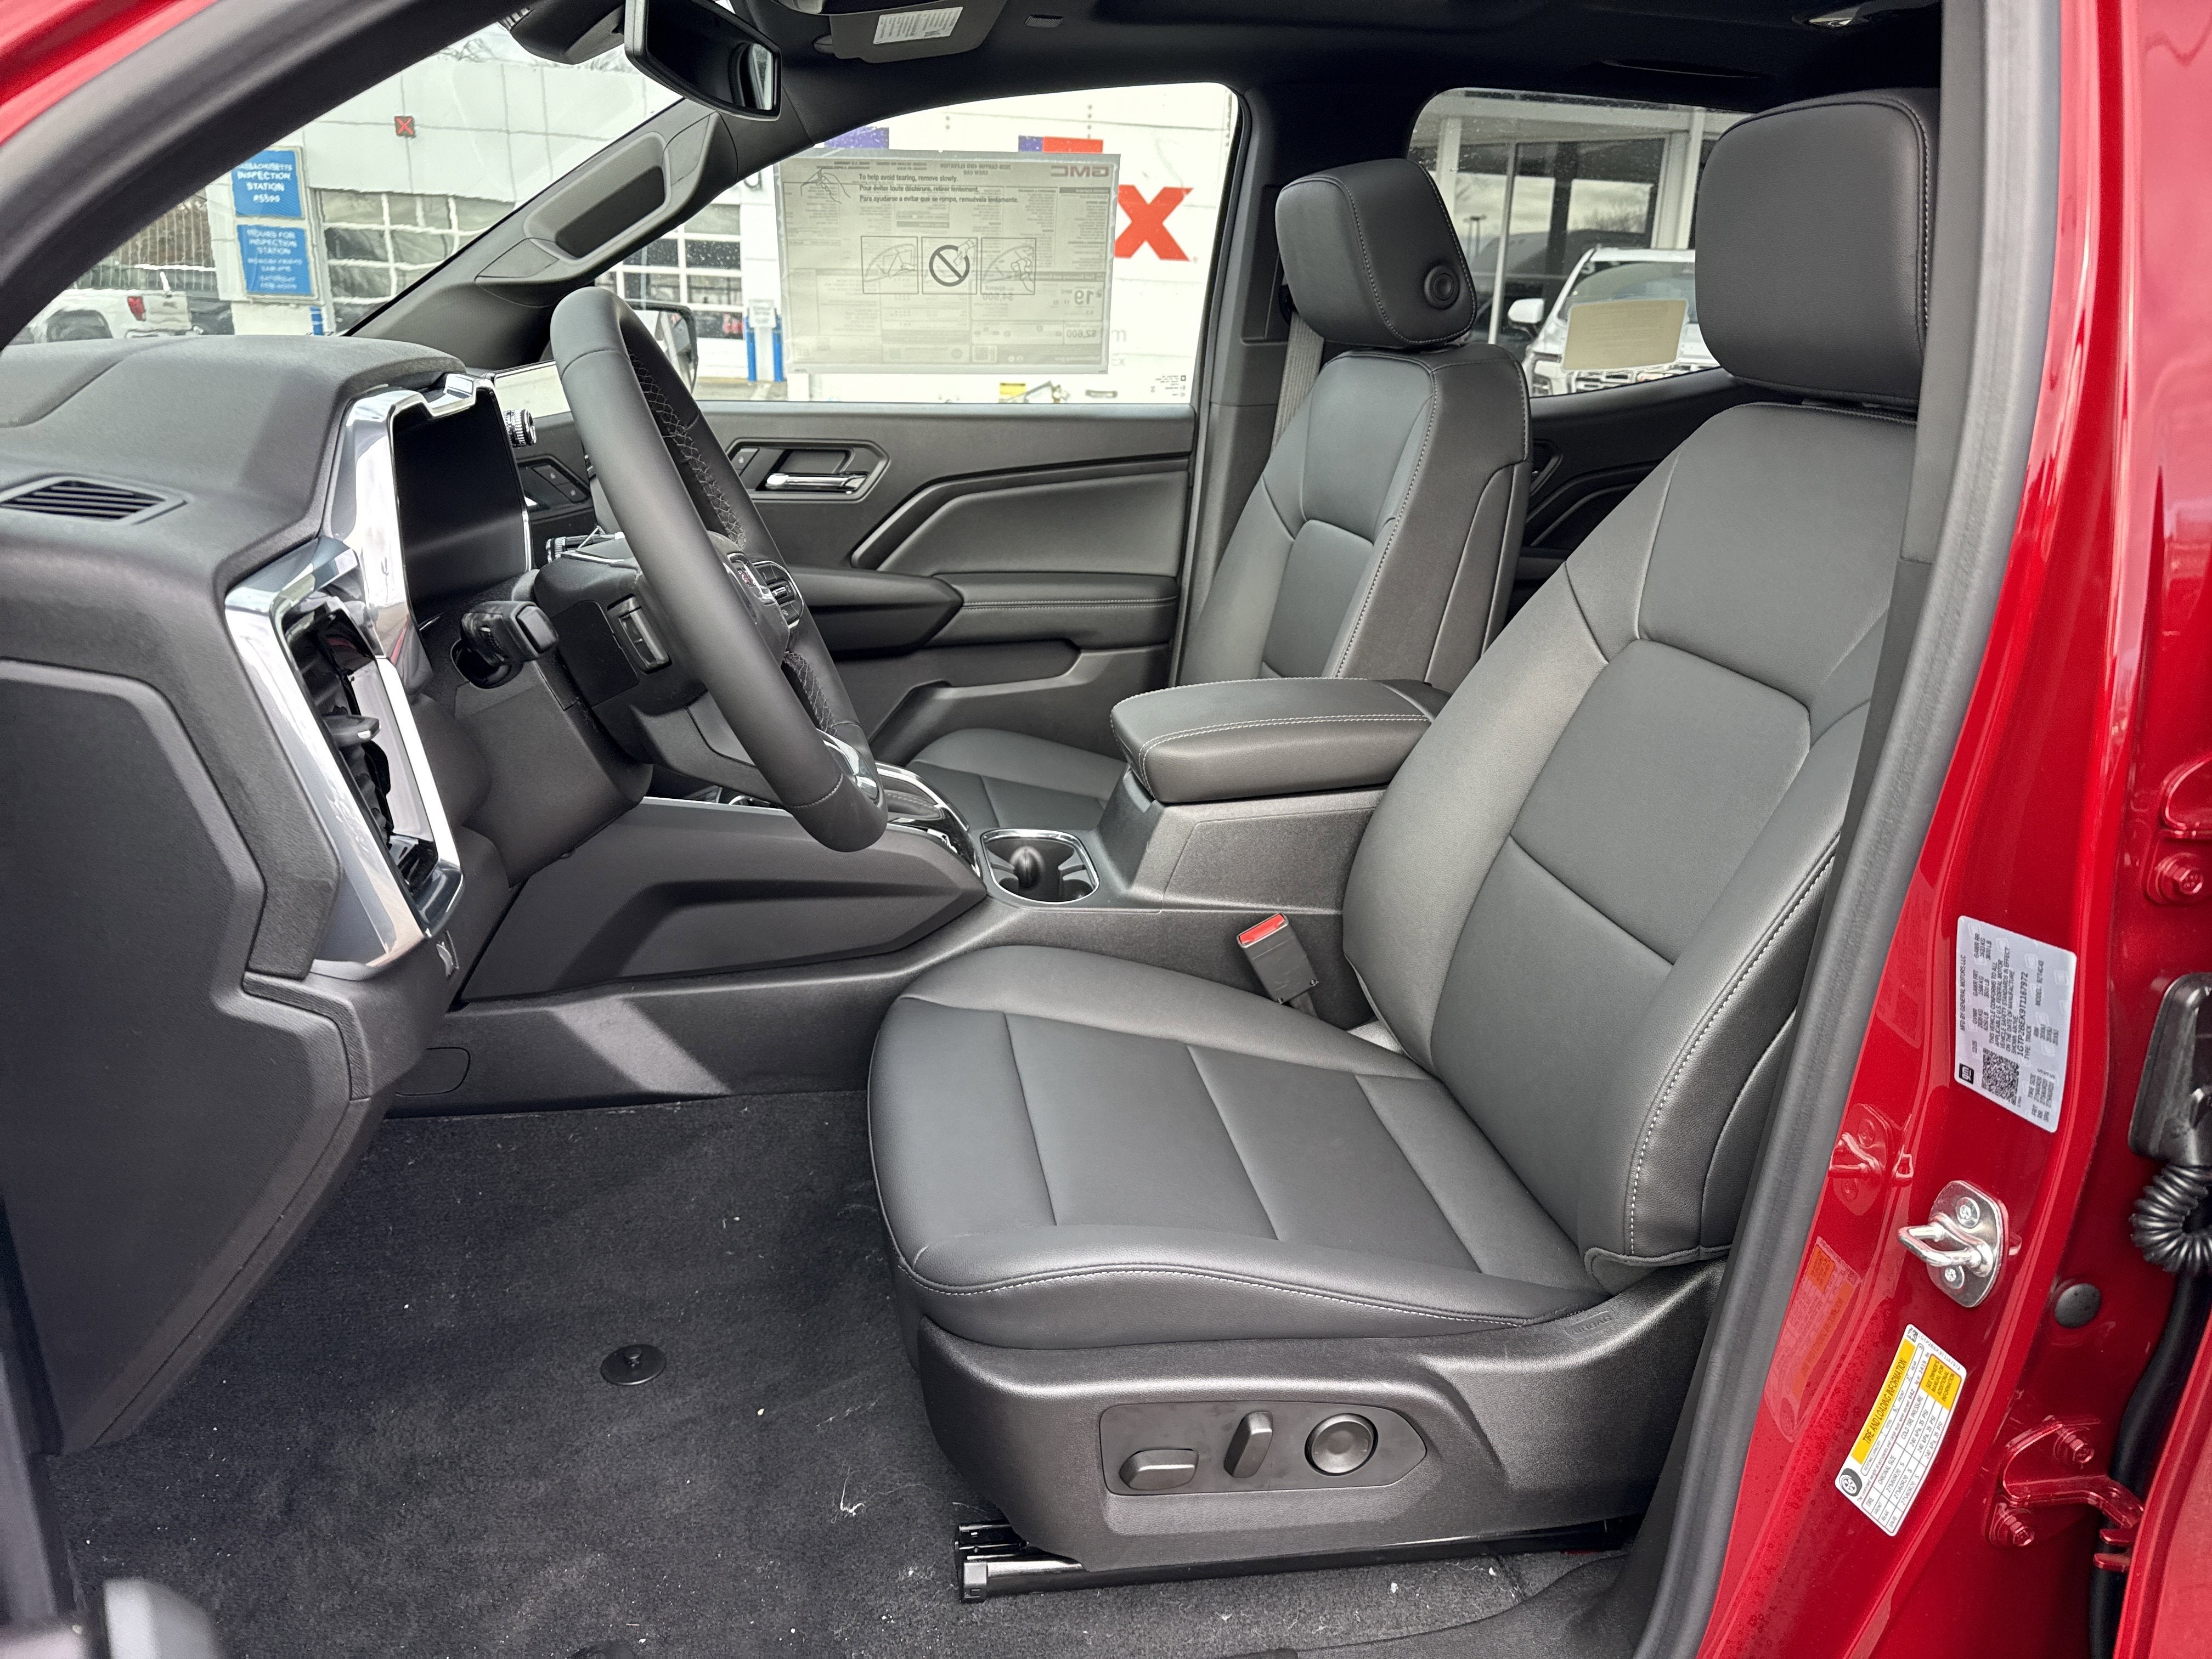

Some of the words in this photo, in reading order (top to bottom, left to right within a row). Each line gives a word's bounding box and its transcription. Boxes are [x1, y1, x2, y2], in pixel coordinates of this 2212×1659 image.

[246, 182, 285, 191] STATION
[2016, 970, 2029, 1057] 1GTP2BEK9T1167972
[1571, 1315, 1612, 1335] AIRBAG
[1884, 1356, 1908, 1397] INFORMATION
[1931, 1374, 1941, 1392] MANUAL
[1936, 1370, 1950, 1396] ADDITIONAL
[1940, 1372, 1956, 1402] INFORMATION
[1874, 1392, 1892, 1421] LOADING
[1862, 1427, 1875, 1446] TIRE
[1869, 1416, 1880, 1433] AND
[1877, 1462, 1891, 1486] ORIGINAL
[1900, 1426, 1909, 1440] COLD
[1910, 1394, 1923, 1419] PRESSURE
